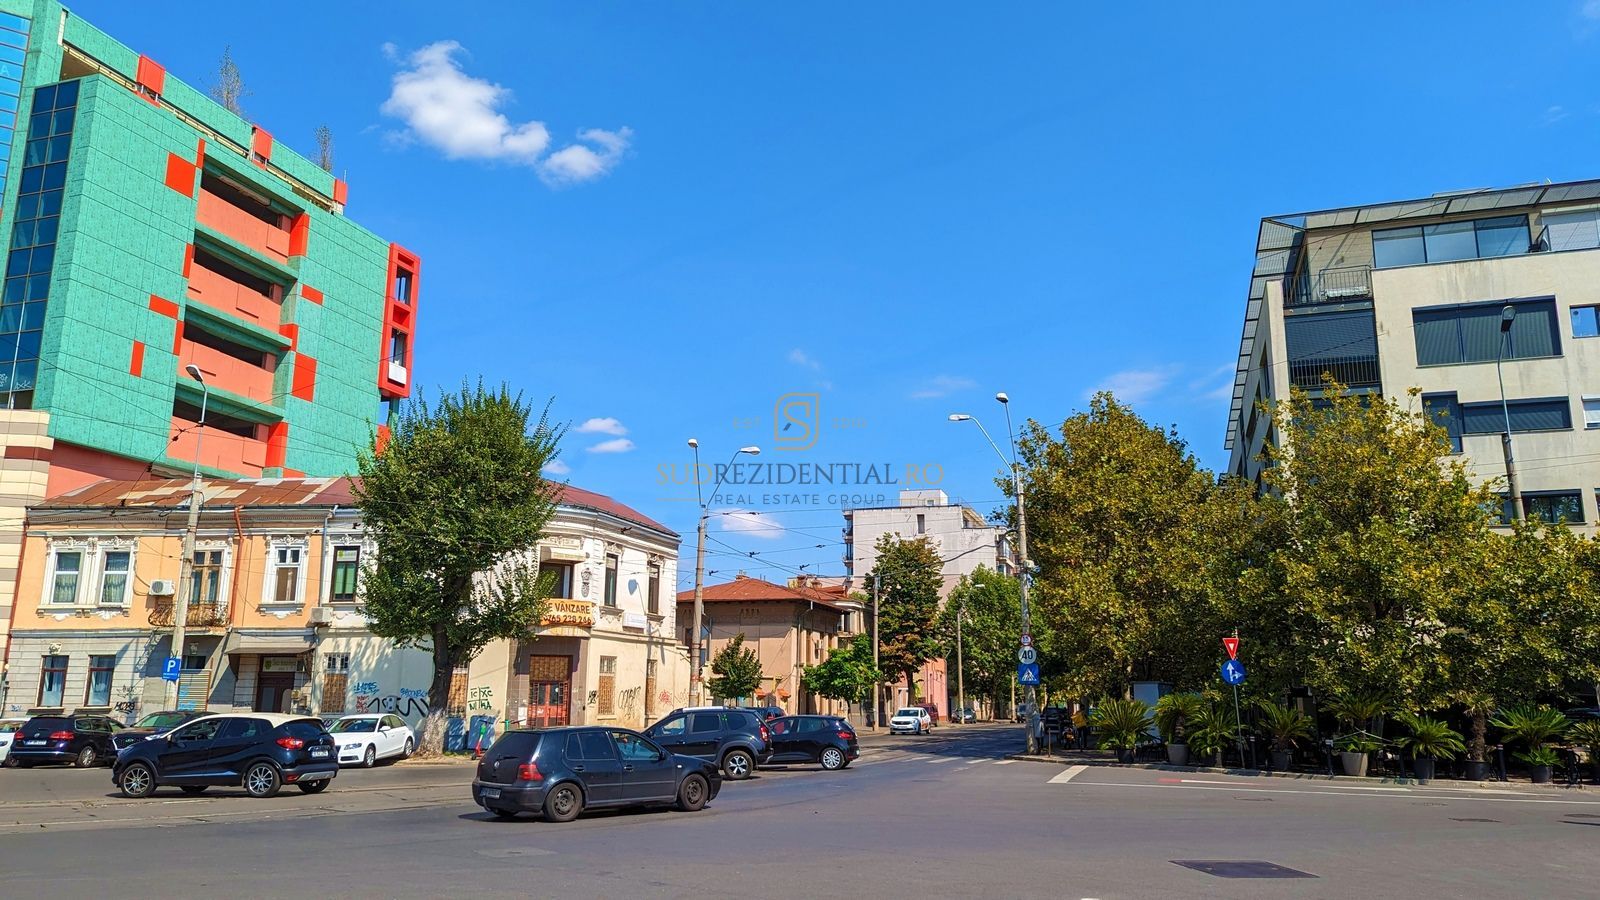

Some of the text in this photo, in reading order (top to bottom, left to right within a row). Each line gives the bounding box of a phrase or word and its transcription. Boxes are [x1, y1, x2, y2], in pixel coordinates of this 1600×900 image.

[554, 601, 591, 614] VÂNZARE
[1022, 650, 1033, 660] 40
[166, 659, 176, 673] P
